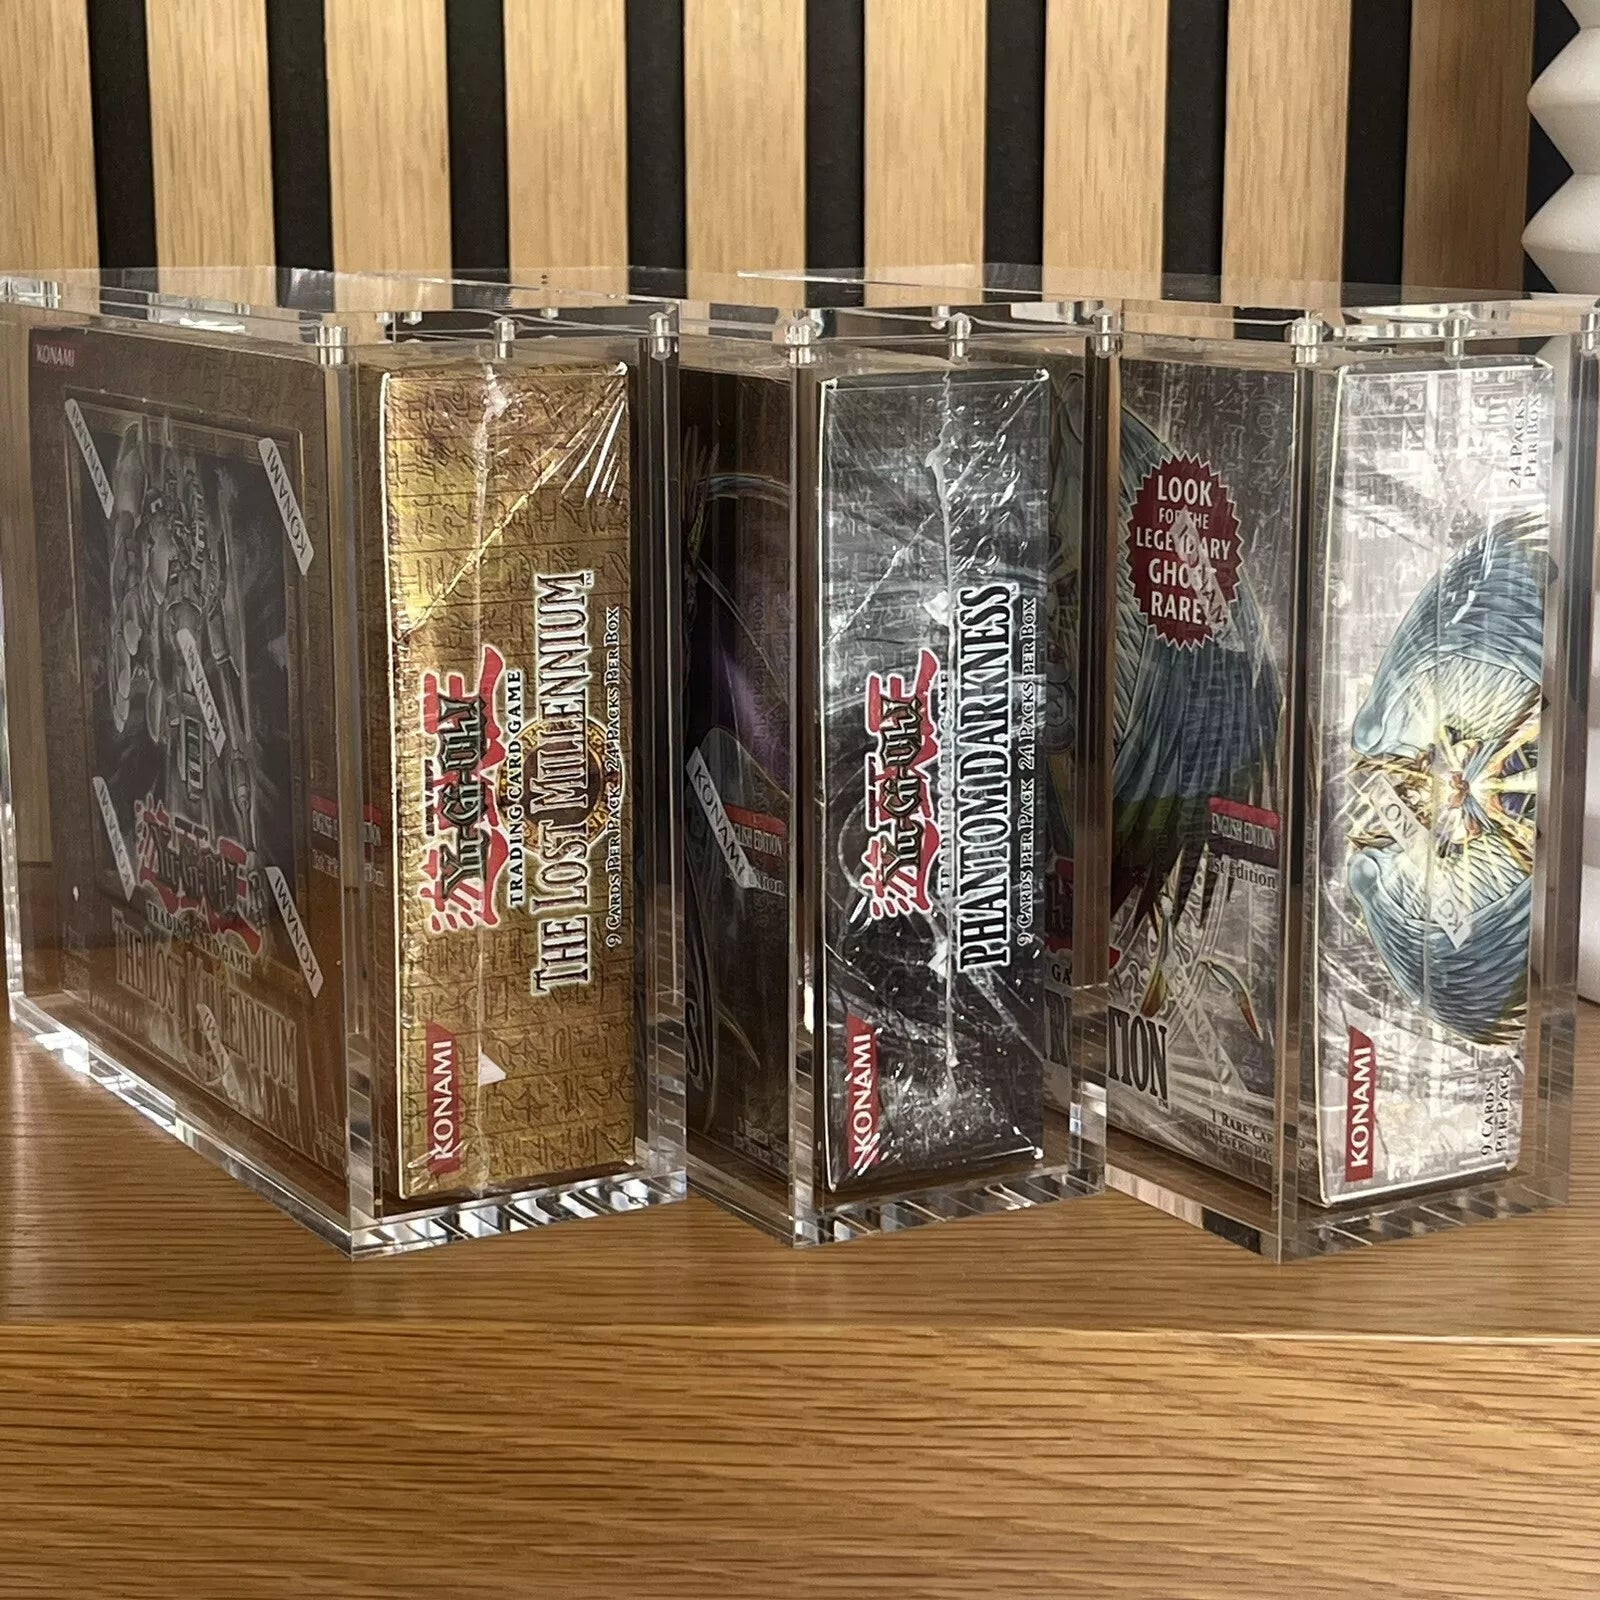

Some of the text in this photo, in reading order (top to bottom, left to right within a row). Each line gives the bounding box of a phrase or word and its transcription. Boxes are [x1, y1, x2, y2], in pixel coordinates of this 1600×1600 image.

[35, 343, 76, 368] KONAMI
[1507, 397, 1526, 489] 24 PACKS
[1523, 393, 1541, 478] PER BOX
[267, 445, 309, 558] KONAMI
[1157, 474, 1213, 507] LOOK
[1020, 597, 1037, 640] BOX
[531, 571, 590, 812] MILLENNIUM
[1019, 680, 1036, 742] PACKS
[436, 694, 490, 900] Yu-Gi-Oh!
[507, 671, 523, 905] TRADING CARD GAME
[604, 606, 621, 949] 9 CARDS PER PACK 24 PACKS PER BOX
[881, 694, 923, 886] Yu-Gi-Oh!
[957, 583, 1012, 970] PHANTOM DARKNESS
[1018, 744, 1035, 771] 24
[693, 765, 747, 868] KONAMI
[1018, 778, 1035, 831] PACK
[528, 819, 589, 907] LOST
[1017, 869, 1034, 929] CARDS
[1228, 860, 1276, 890] Edition
[222, 945, 251, 976] GAME
[272, 876, 319, 982] KONAMI
[532, 917, 590, 993] THE
[1016, 931, 1034, 947] 9
[431, 1040, 455, 1162] KONAMI
[852, 1033, 873, 1154] KONAMI
[1220, 1112, 1250, 1136] RARE
[1350, 1046, 1372, 1168] KONAMI
[1480, 1081, 1495, 1156] 9 CARDS
[1495, 1066, 1511, 1153] PER PACK
